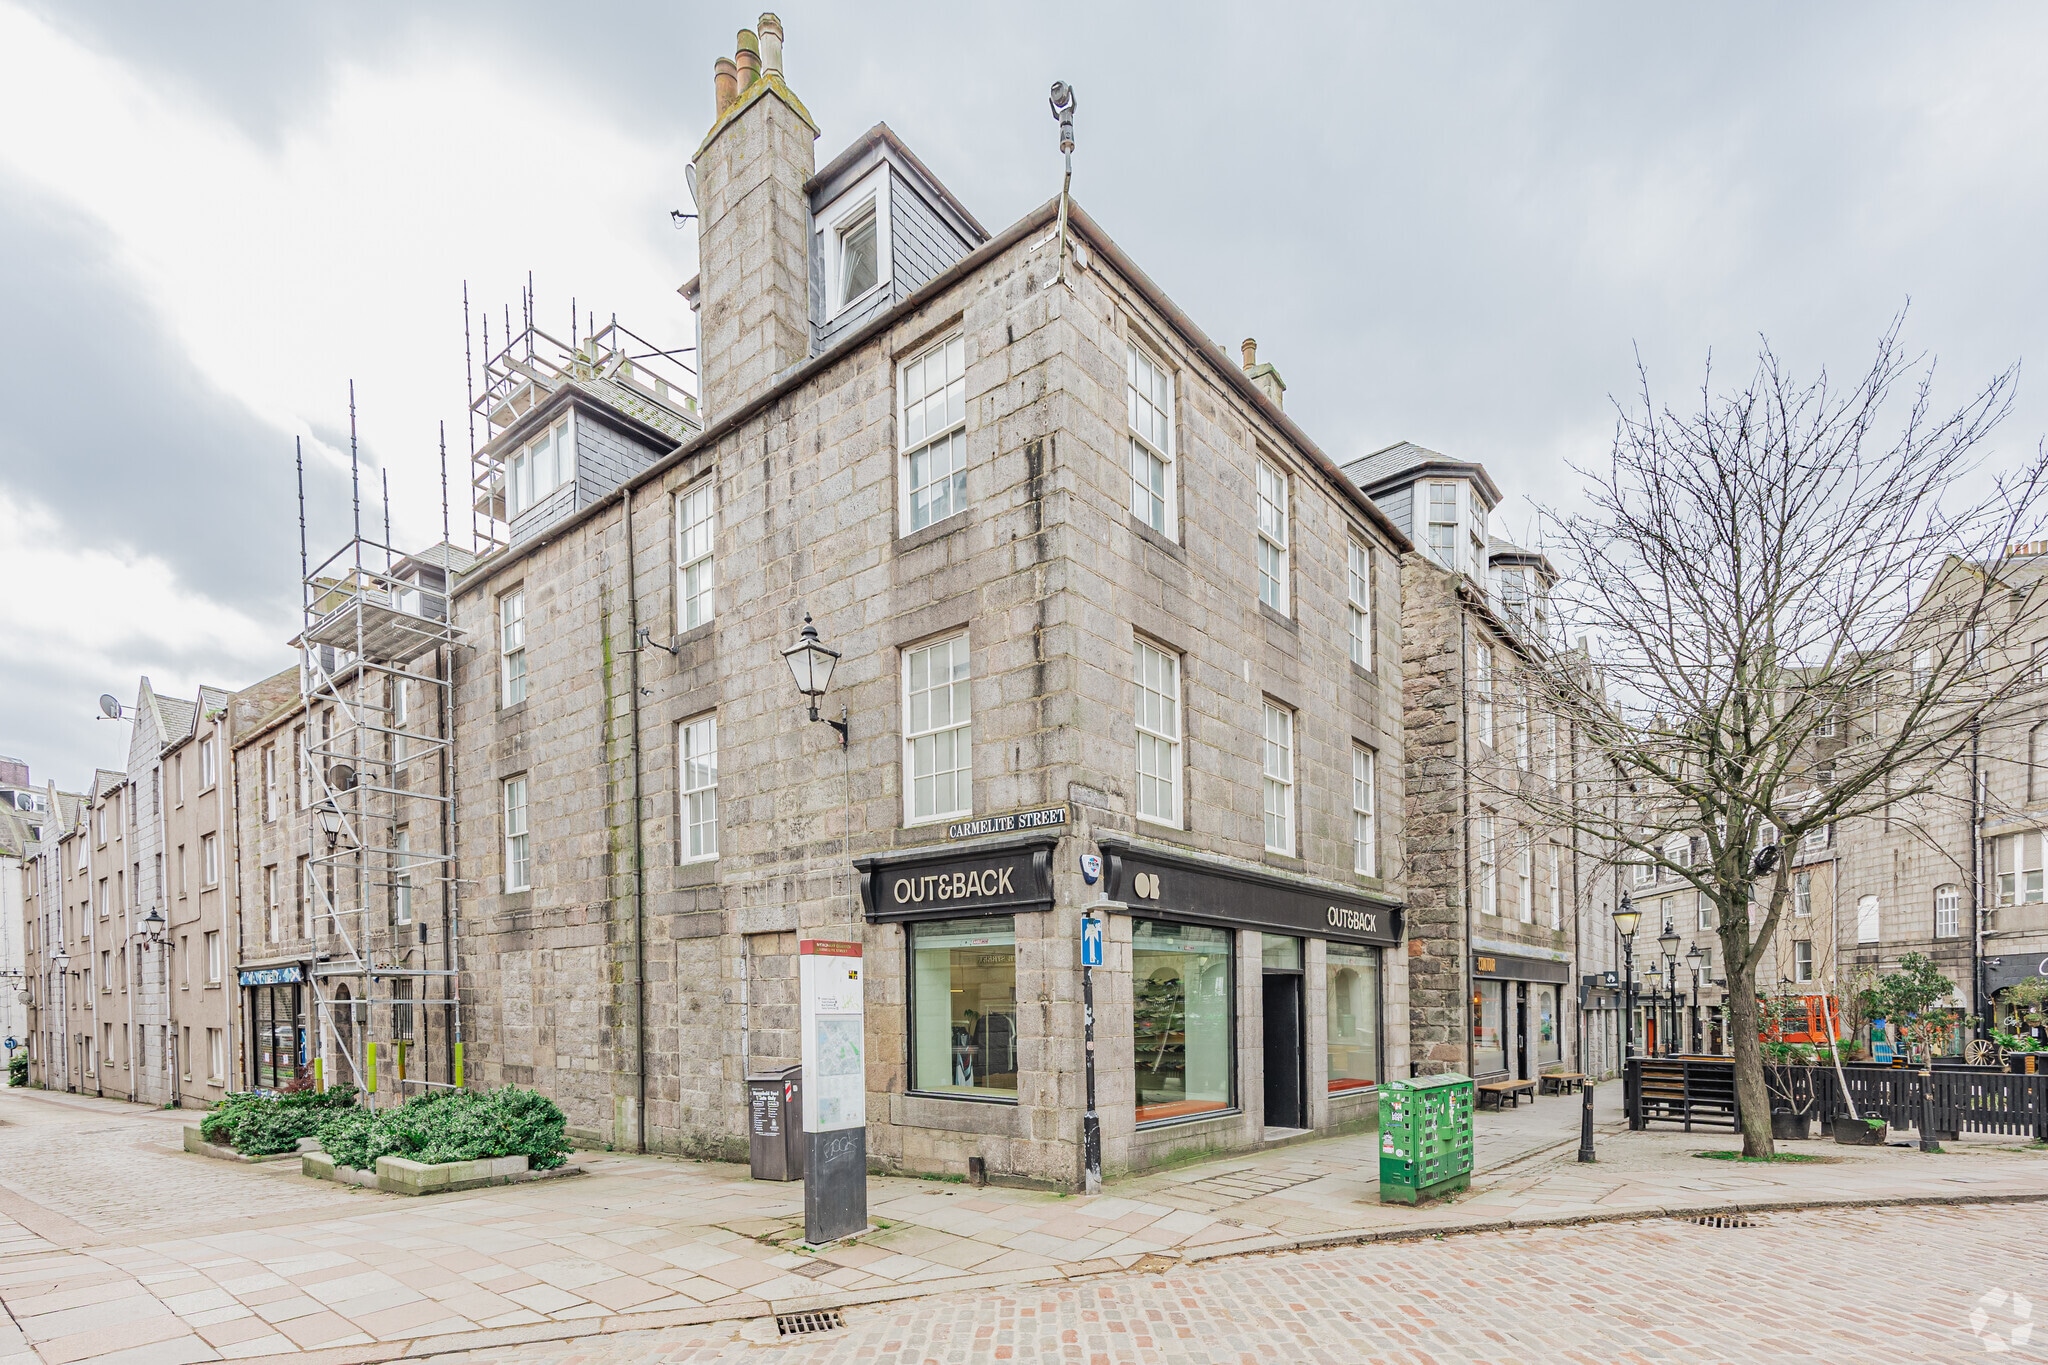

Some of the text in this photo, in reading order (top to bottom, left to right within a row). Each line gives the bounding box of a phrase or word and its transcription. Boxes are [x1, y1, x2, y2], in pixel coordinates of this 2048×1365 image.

[949, 808, 1066, 839] CARMELITE STREET
[893, 867, 1014, 904] OUT&BACK
[1327, 906, 1377, 932] OUT&BACK
